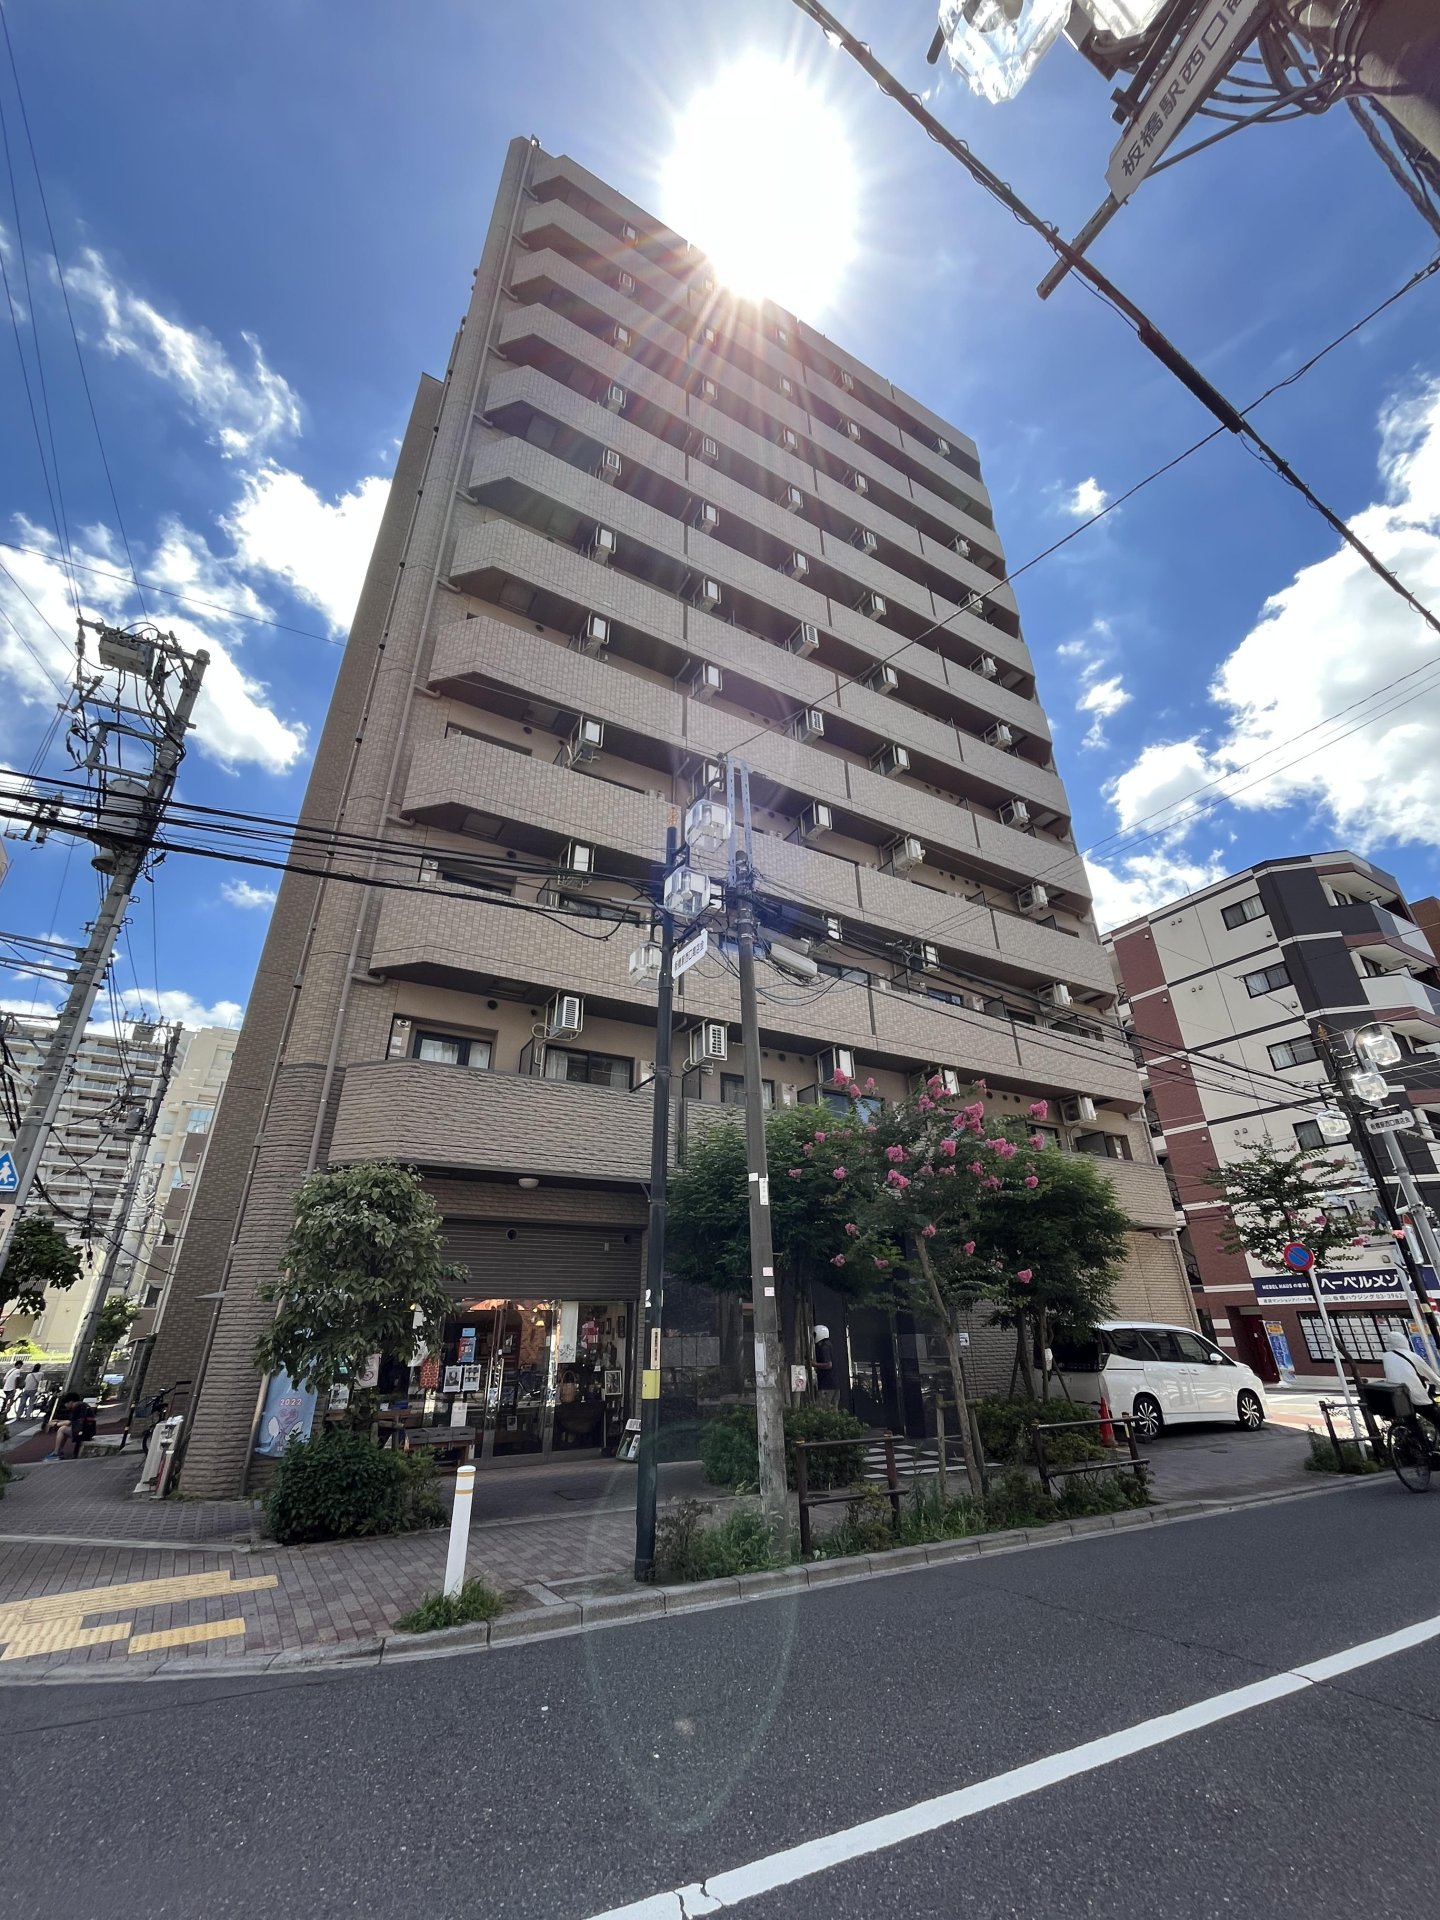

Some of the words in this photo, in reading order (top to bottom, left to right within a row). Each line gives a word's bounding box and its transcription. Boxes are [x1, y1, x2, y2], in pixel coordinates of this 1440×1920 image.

[1321, 1274, 1412, 1290] ヘーベルメゾ
[1376, 1292, 1412, 1300] 03-3962-
[280, 1398, 302, 1406] 2022
